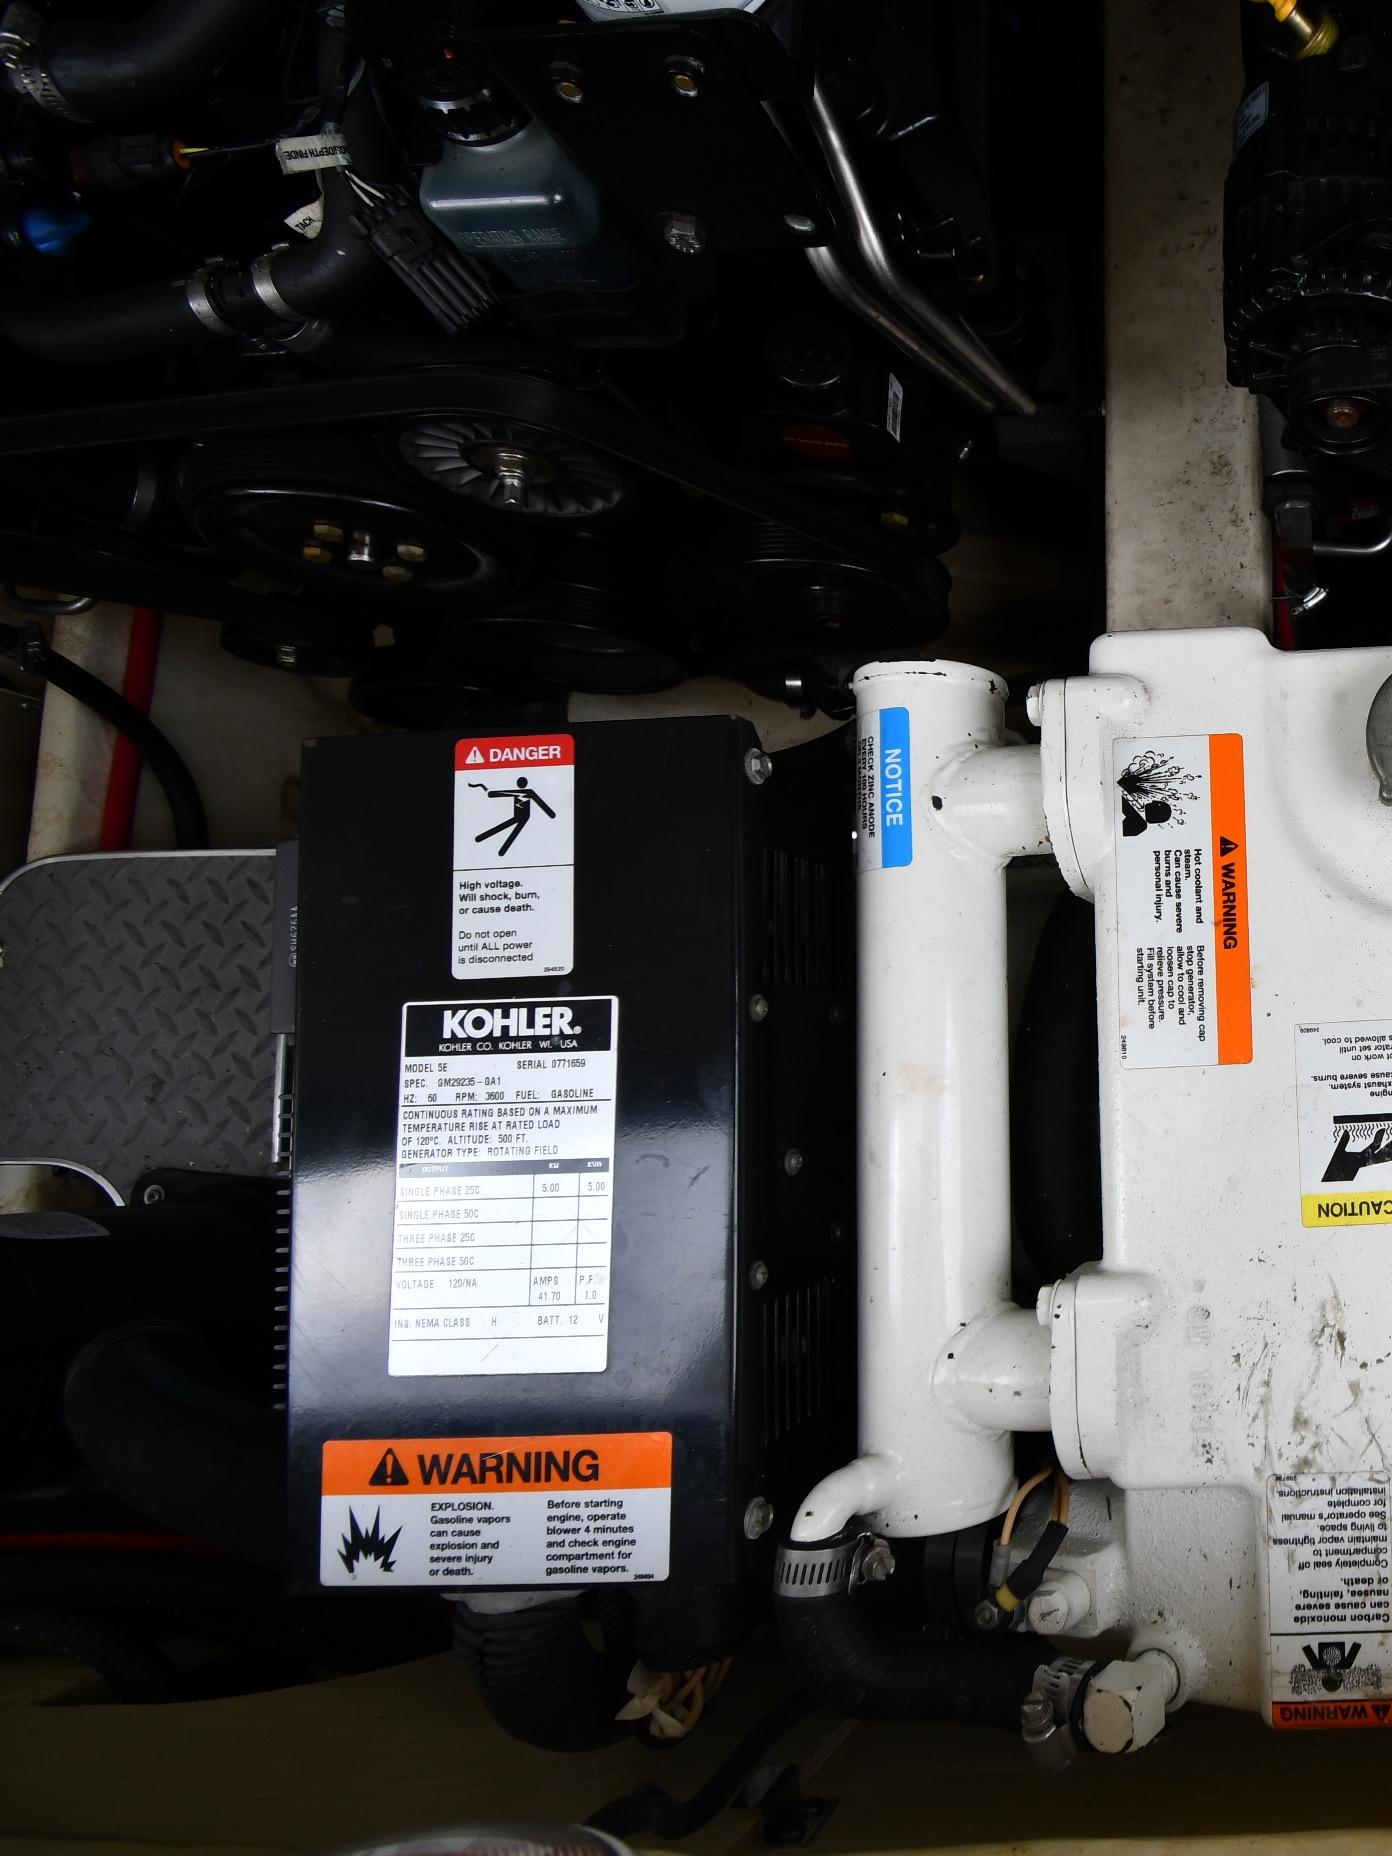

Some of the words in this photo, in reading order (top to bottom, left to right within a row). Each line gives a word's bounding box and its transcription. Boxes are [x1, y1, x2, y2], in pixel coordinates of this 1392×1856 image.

[284, 150, 308, 160] FINDE
[296, 216, 315, 230] TACH
[490, 745, 561, 762] DANGER
[885, 749, 903, 826] NOTICE
[1194, 849, 1202, 865] Hot
[1164, 850, 1172, 877] burns
[1184, 849, 1192, 880] steam.
[1153, 851, 1162, 891] personal
[460, 881, 481, 890] High
[485, 880, 523, 890] voltage.
[1165, 880, 1173, 897] and
[1194, 868, 1203, 903] coolant
[459, 893, 476, 902] Will
[480, 892, 511, 902] shock,
[515, 891, 539, 900] burn,
[472, 906, 501, 914] cause
[504, 903, 534, 913] death.
[1154, 894, 1163, 922] injury.
[1221, 863, 1237, 949] WARNING
[1195, 906, 1203, 923] and
[459, 930, 472, 939] Do
[475, 930, 490, 939] not
[493, 930, 517, 939] open
[458, 942, 479, 951] until
[481, 941, 500, 950] ALL
[503, 941, 532, 951] power
[458, 955, 465, 964] is
[469, 953, 533, 963] disconnected
[1147, 948, 1155, 960] Fill
[1177, 946, 1185, 969] allow
[1186, 946, 1194, 966] stop
[1197, 946, 1205, 975] Before
[1146, 963, 1155, 996] system
[1177, 973, 1185, 982] to
[1186, 969, 1195, 1015] generator,
[1197, 978, 1206, 1021] removing
[1148, 999, 1156, 1029] before
[1198, 1025, 1206, 1041] cap
[439, 1042, 472, 1052] KOHLER
[499, 1041, 532, 1050] KOHLER
[560, 1040, 577, 1048] USA
[405, 1064, 433, 1073] MODEL
[438, 1063, 447, 1072] 5E
[517, 1060, 547, 1069] SERIAL
[552, 1059, 585, 1068] 0771659
[1329, 1082, 1361, 1090] system.
[428, 1094, 437, 1102] 60
[456, 1093, 477, 1101] RPM:
[485, 1091, 504, 1100] 3600
[516, 1091, 540, 1099] FUEL:
[551, 1089, 593, 1098] GASOLINE
[403, 1110, 458, 1119] CONTINUOUS
[462, 1109, 493, 1118] RATING
[498, 1108, 526, 1117] BASED
[529, 1107, 540, 1116] ON
[544, 1107, 549, 1116] A
[553, 1106, 598, 1115] MAXIMUM
[403, 1123, 465, 1133] TEMPERATURE
[469, 1122, 488, 1131] RISE
[492, 1121, 502, 1130] AT
[506, 1121, 534, 1130] RATED
[538, 1120, 560, 1128] LOAD
[417, 1450, 599, 1485] WARNING
[431, 1501, 494, 1511] EXPLOSION.
[548, 1499, 581, 1509] Before
[584, 1498, 623, 1509] starting
[431, 1515, 474, 1524] Gasoline
[477, 1514, 510, 1525] vapors
[547, 1513, 584, 1523] engine,
[587, 1511, 626, 1523] operate
[430, 1529, 448, 1537] can
[451, 1528, 481, 1537] cause
[547, 1525, 581, 1535] blower
[584, 1526, 590, 1534] 4
[593, 1524, 634, 1534] minutes
[430, 1540, 479, 1551] explosion
[481, 1539, 499, 1549] and
[546, 1538, 565, 1548] and
[568, 1537, 599, 1547] check
[602, 1538, 636, 1548] engine
[430, 1555, 462, 1563] severe
[465, 1553, 493, 1565] injury
[546, 1551, 615, 1562] compartment
[617, 1550, 632, 1560] for
[429, 1568, 439, 1576] or
[442, 1566, 474, 1576] death.
[546, 1565, 591, 1576] gasoline
[592, 1564, 629, 1574] vapors.
[1377, 1577, 1388, 1585] or
[1295, 1603, 1330, 1612] severe
[1335, 1602, 1366, 1611] cause
[1370, 1602, 1389, 1610] can
[1294, 1615, 1346, 1624] monoxide
[1350, 1613, 1390, 1623] Carbon
[1280, 1705, 1367, 1721] WARNING
